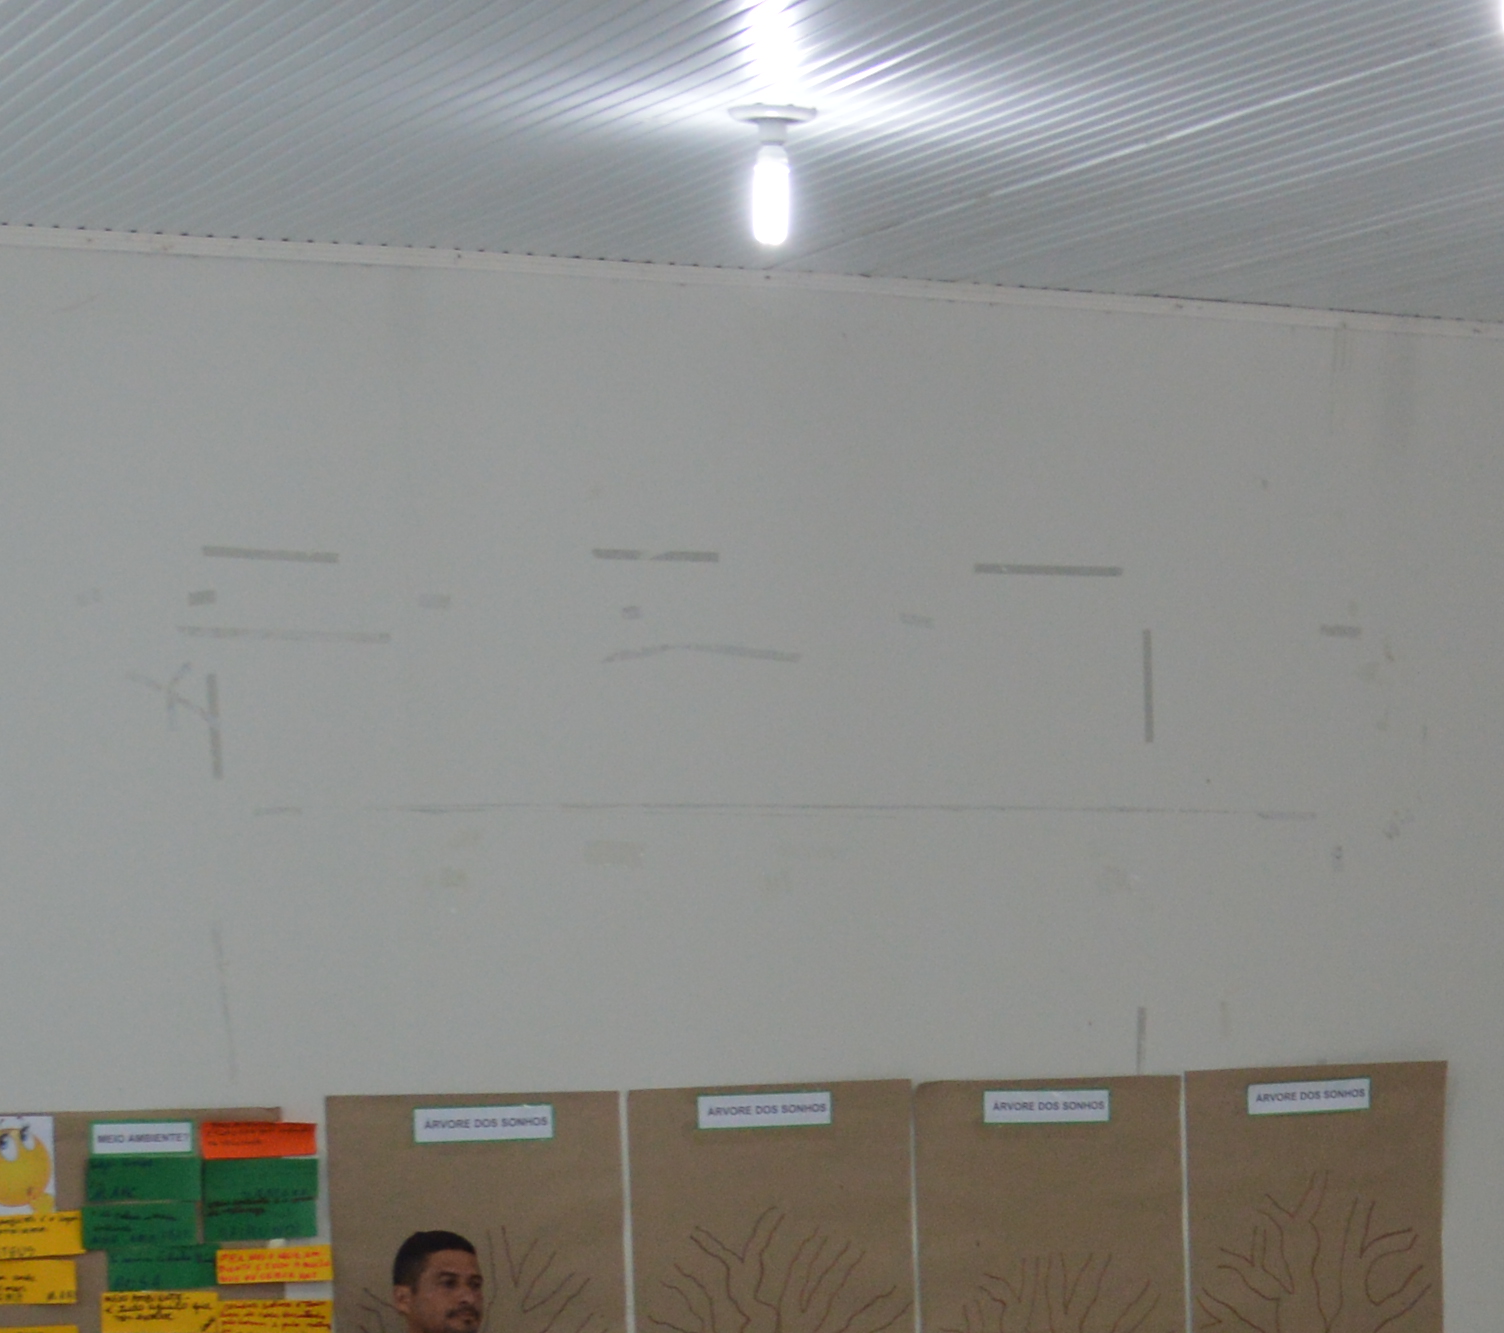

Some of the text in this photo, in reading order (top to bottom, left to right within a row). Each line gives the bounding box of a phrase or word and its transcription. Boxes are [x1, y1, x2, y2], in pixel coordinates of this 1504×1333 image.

[1256, 1088, 1365, 1102] ÁRVORE DOS SONHOS
[708, 1103, 826, 1116] ÁRVORE DOS SONHOS
[993, 1100, 1105, 1111] ÁRVORE DOS SONHOS
[424, 1116, 548, 1129] ÁRVORE DOS SONHOS
[97, 1133, 189, 1144] MEIO AMBIENTE?
